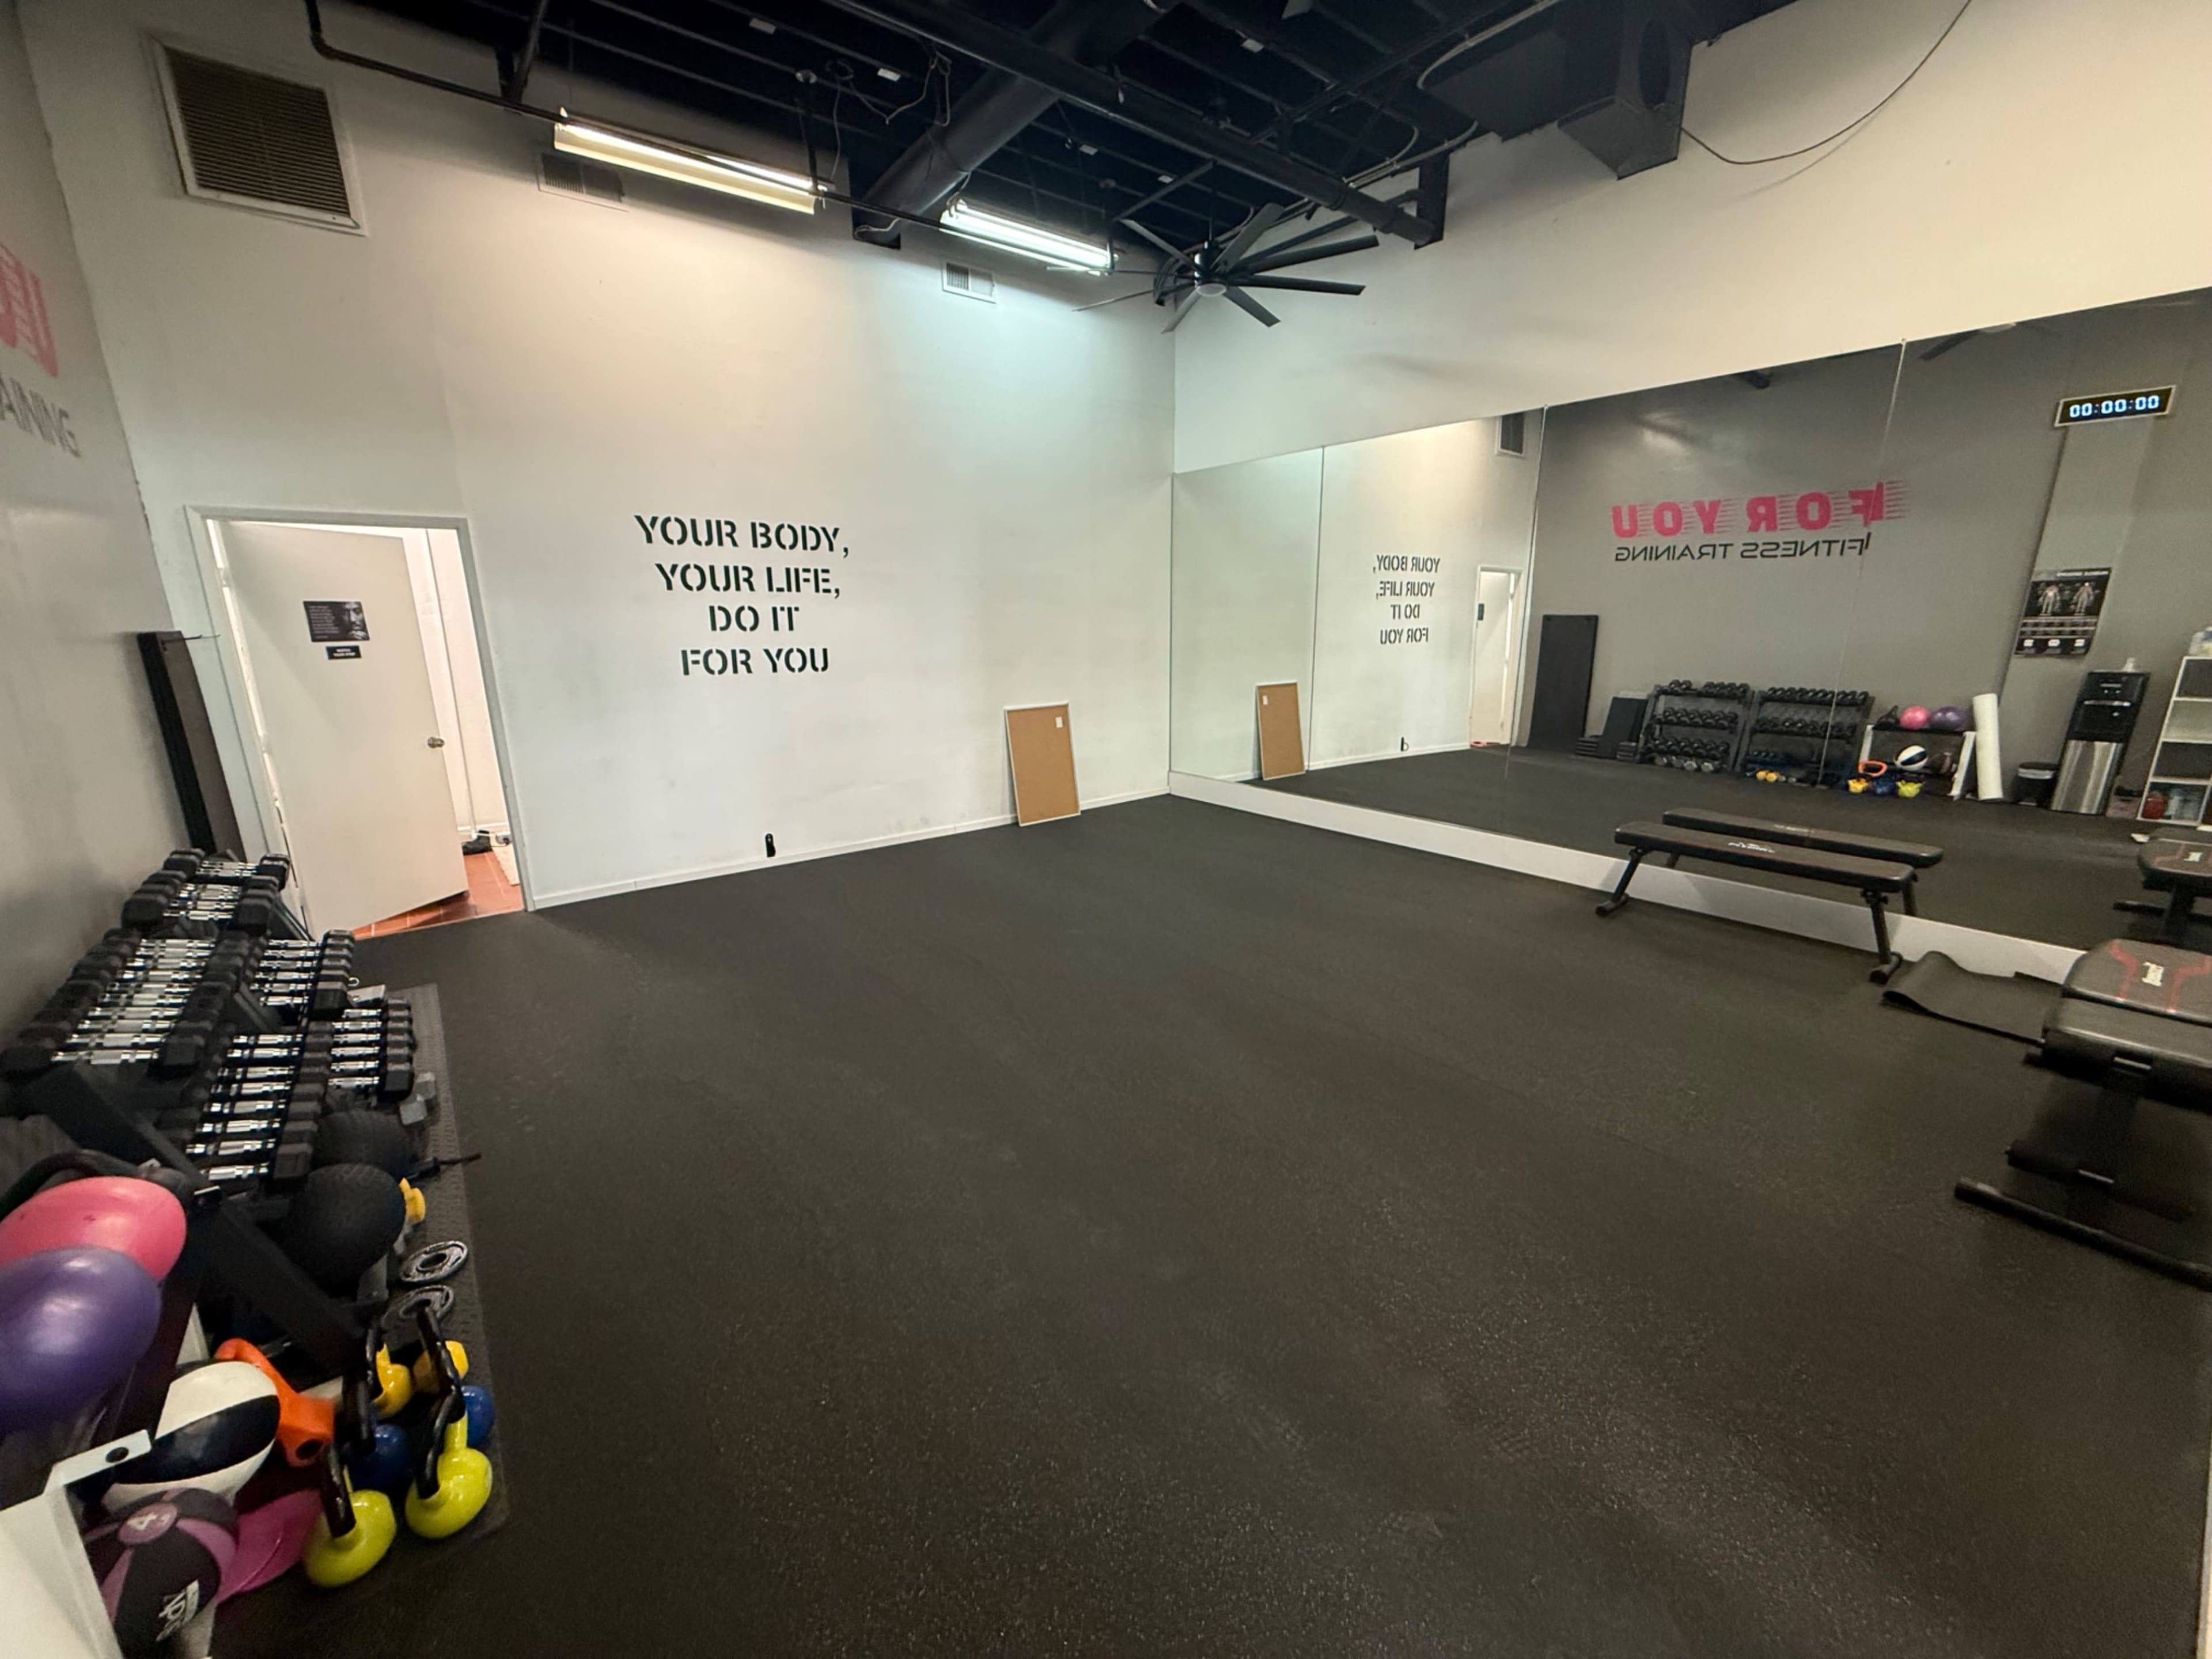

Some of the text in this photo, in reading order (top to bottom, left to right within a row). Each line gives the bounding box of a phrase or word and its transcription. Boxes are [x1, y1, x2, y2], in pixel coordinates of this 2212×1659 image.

[634, 515, 849, 558] YOUR BODY,
[655, 563, 840, 599] YOUR LIFE,
[709, 605, 800, 631] DO IT
[681, 647, 828, 675] FOR YOU
